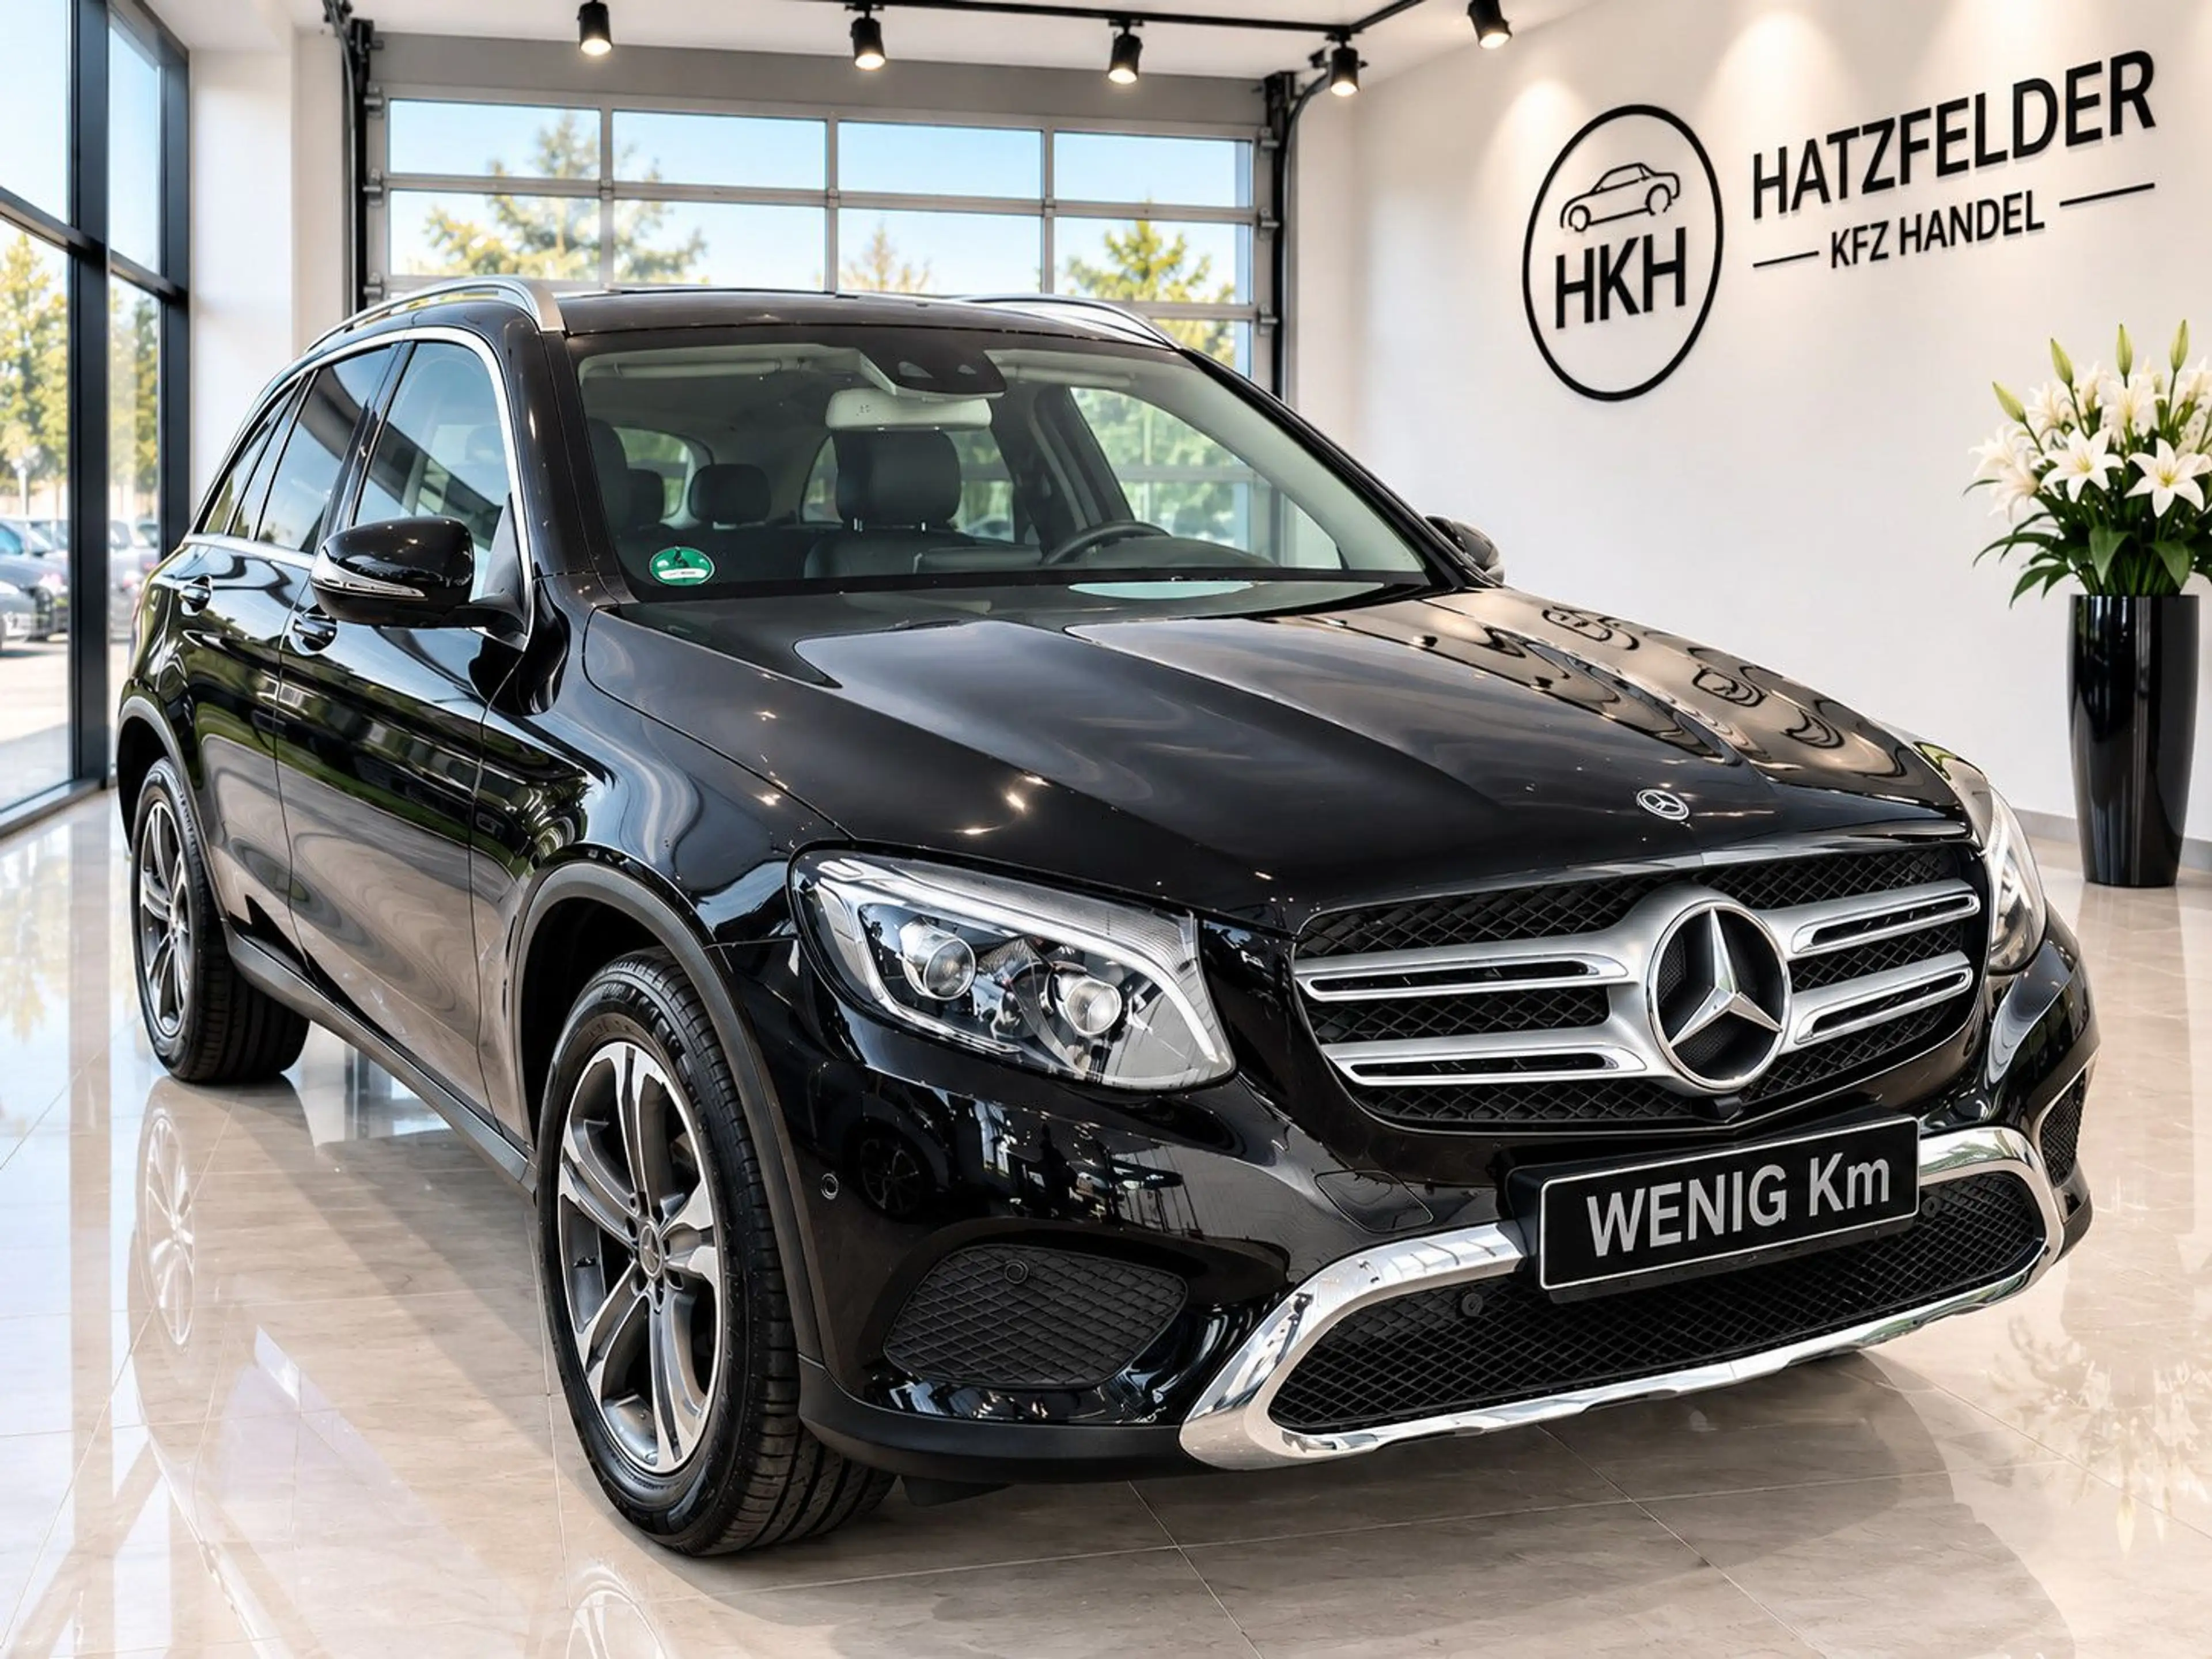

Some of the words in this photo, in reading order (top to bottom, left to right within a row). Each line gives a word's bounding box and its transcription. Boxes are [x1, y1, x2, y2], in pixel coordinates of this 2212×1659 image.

[1753, 50, 2157, 219] HATZFELDER
[1555, 226, 1687, 329] HKH
[1831, 220, 1889, 269] KFZ
[1900, 190, 2046, 256] HANDEL
[1586, 1164, 1787, 1257] WENIG
[1808, 1152, 1890, 1217] Km
